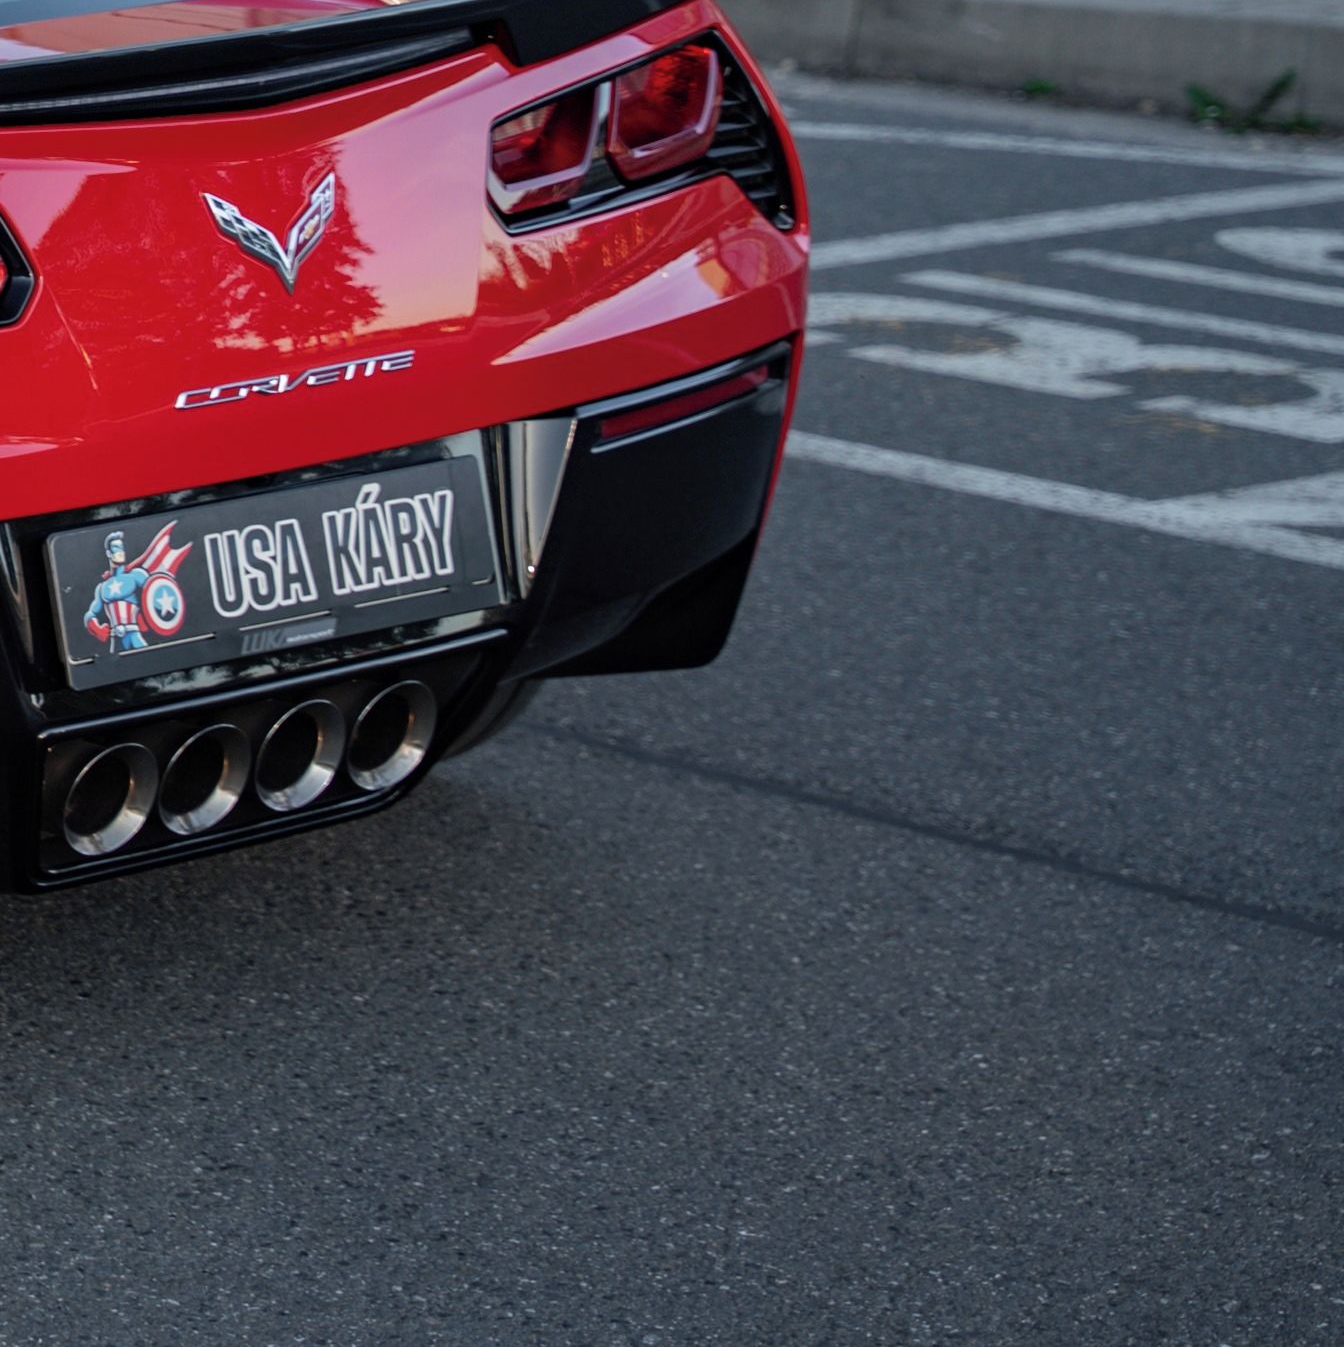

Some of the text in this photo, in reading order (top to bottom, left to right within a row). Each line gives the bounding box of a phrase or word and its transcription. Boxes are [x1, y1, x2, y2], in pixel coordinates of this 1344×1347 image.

[174, 349, 415, 409] CORVETTE
[204, 482, 454, 618] USA KÁRY
